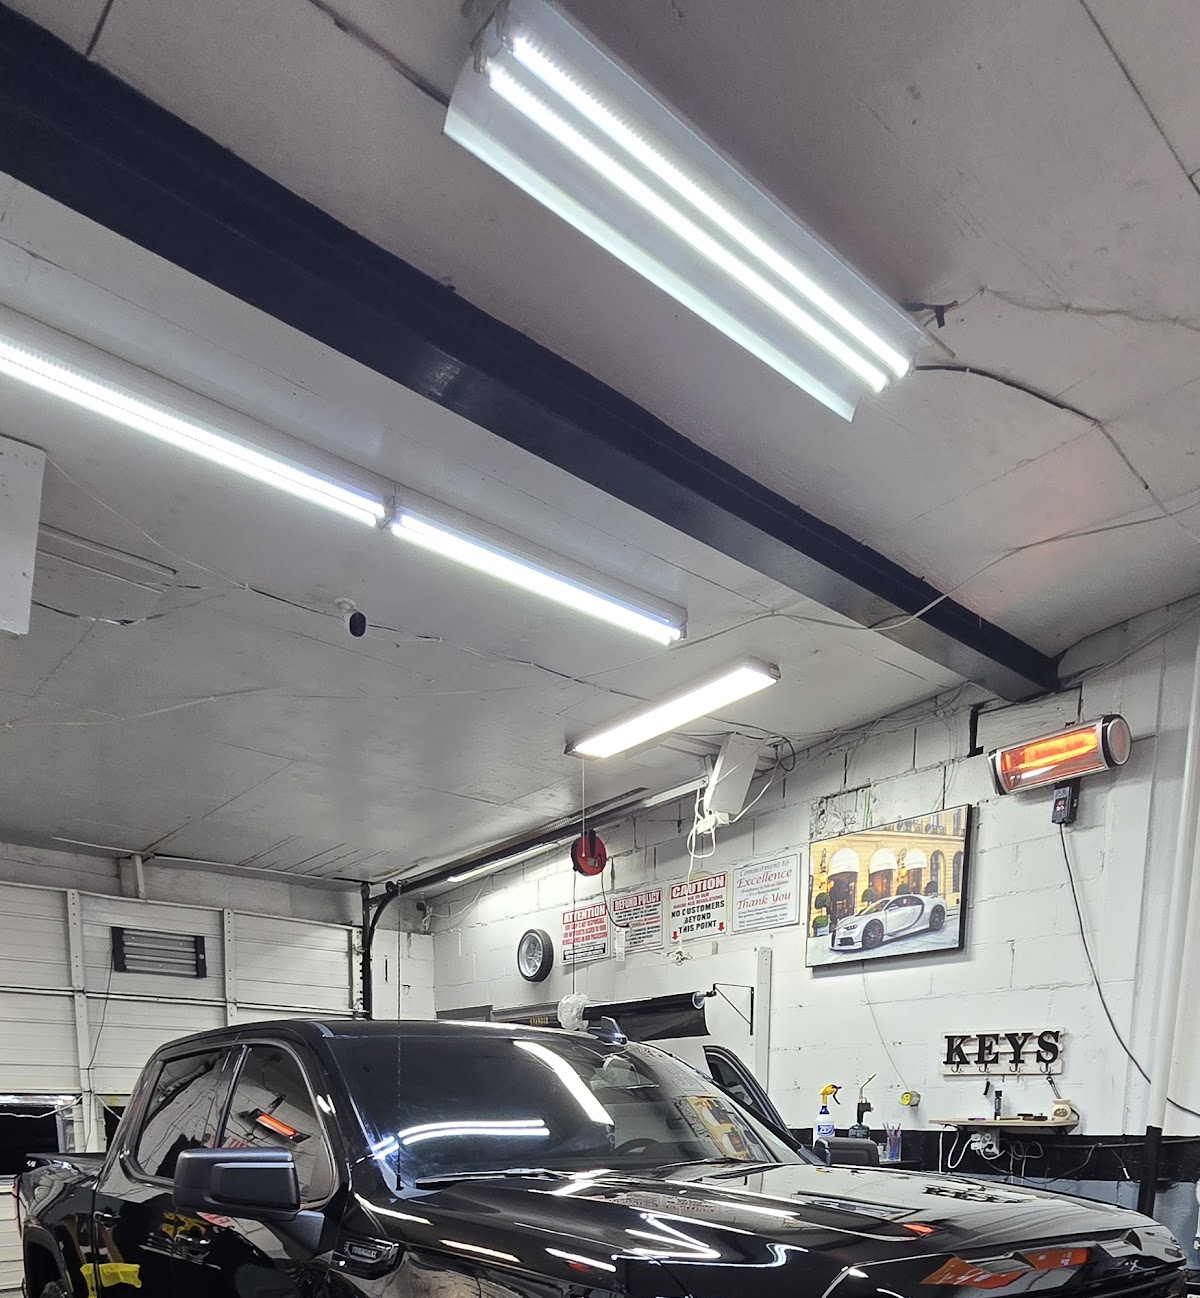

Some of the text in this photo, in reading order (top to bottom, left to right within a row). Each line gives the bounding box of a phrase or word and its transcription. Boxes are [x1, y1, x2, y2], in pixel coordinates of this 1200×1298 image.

[672, 875, 725, 898] CAUTION
[736, 869, 792, 888] Excellence
[615, 891, 660, 910] REFUND POLICY
[671, 910, 680, 918] NO
[682, 900, 724, 916] CUSTOMERS
[736, 893, 790, 909] Thank You
[564, 904, 606, 922] ATTENTION
[684, 912, 711, 924] BEYOND
[679, 920, 717, 934] THIS POINT
[943, 1030, 1060, 1065] KEYS
